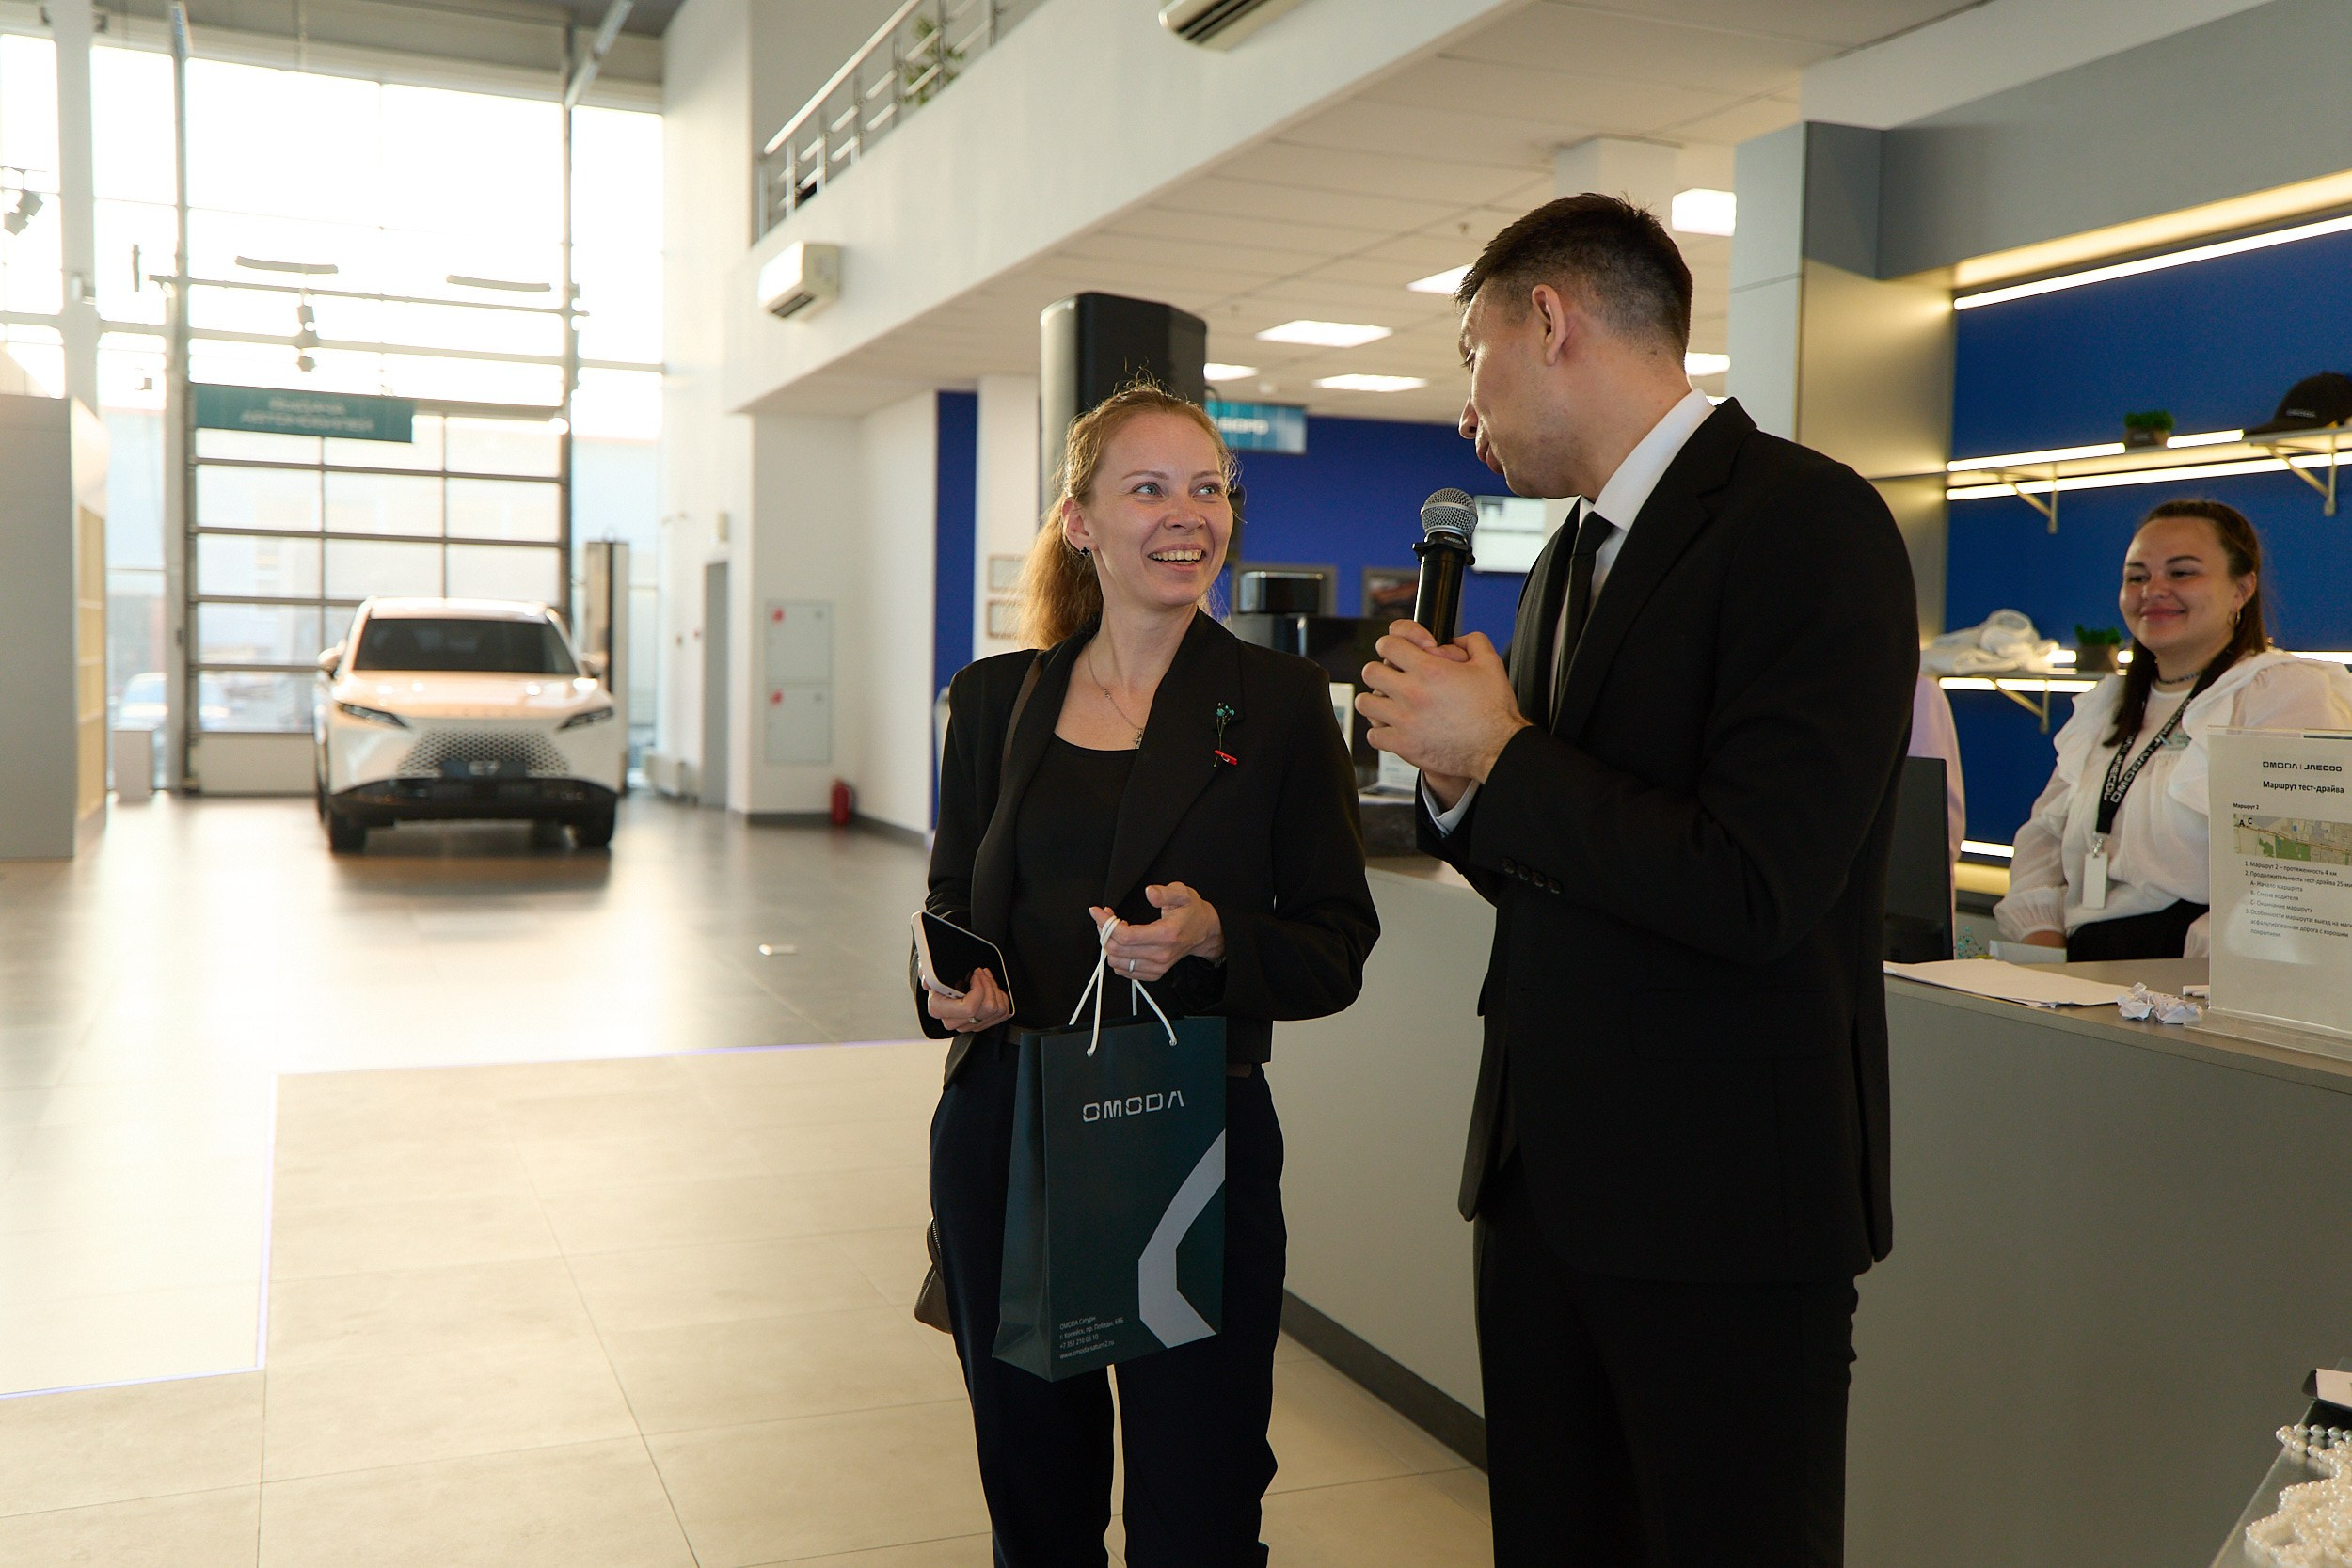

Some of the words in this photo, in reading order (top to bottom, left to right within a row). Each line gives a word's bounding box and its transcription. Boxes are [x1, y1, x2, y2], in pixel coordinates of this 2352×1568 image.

[2262, 761, 2298, 770] OMODA
[2303, 764, 2343, 772] JAECOO
[2263, 781, 2296, 791] Маршрут
[2298, 784, 2344, 794] тест-драйва
[2249, 861, 2274, 870] Маршрут
[2283, 865, 2324, 875] протяженность
[2249, 871, 2303, 882] Продолжительность
[2277, 884, 2303, 893] маршрута
[2250, 909, 2284, 919] Особенности
[2286, 905, 2312, 913] маршрута
[1082, 1090, 1185, 1123] OMODA
[1059, 1320, 1079, 1330] OMODA
[1079, 1316, 1096, 1324] Сатурн
[1076, 1337, 1085, 1346] 210
[1092, 1333, 1099, 1341] 10
